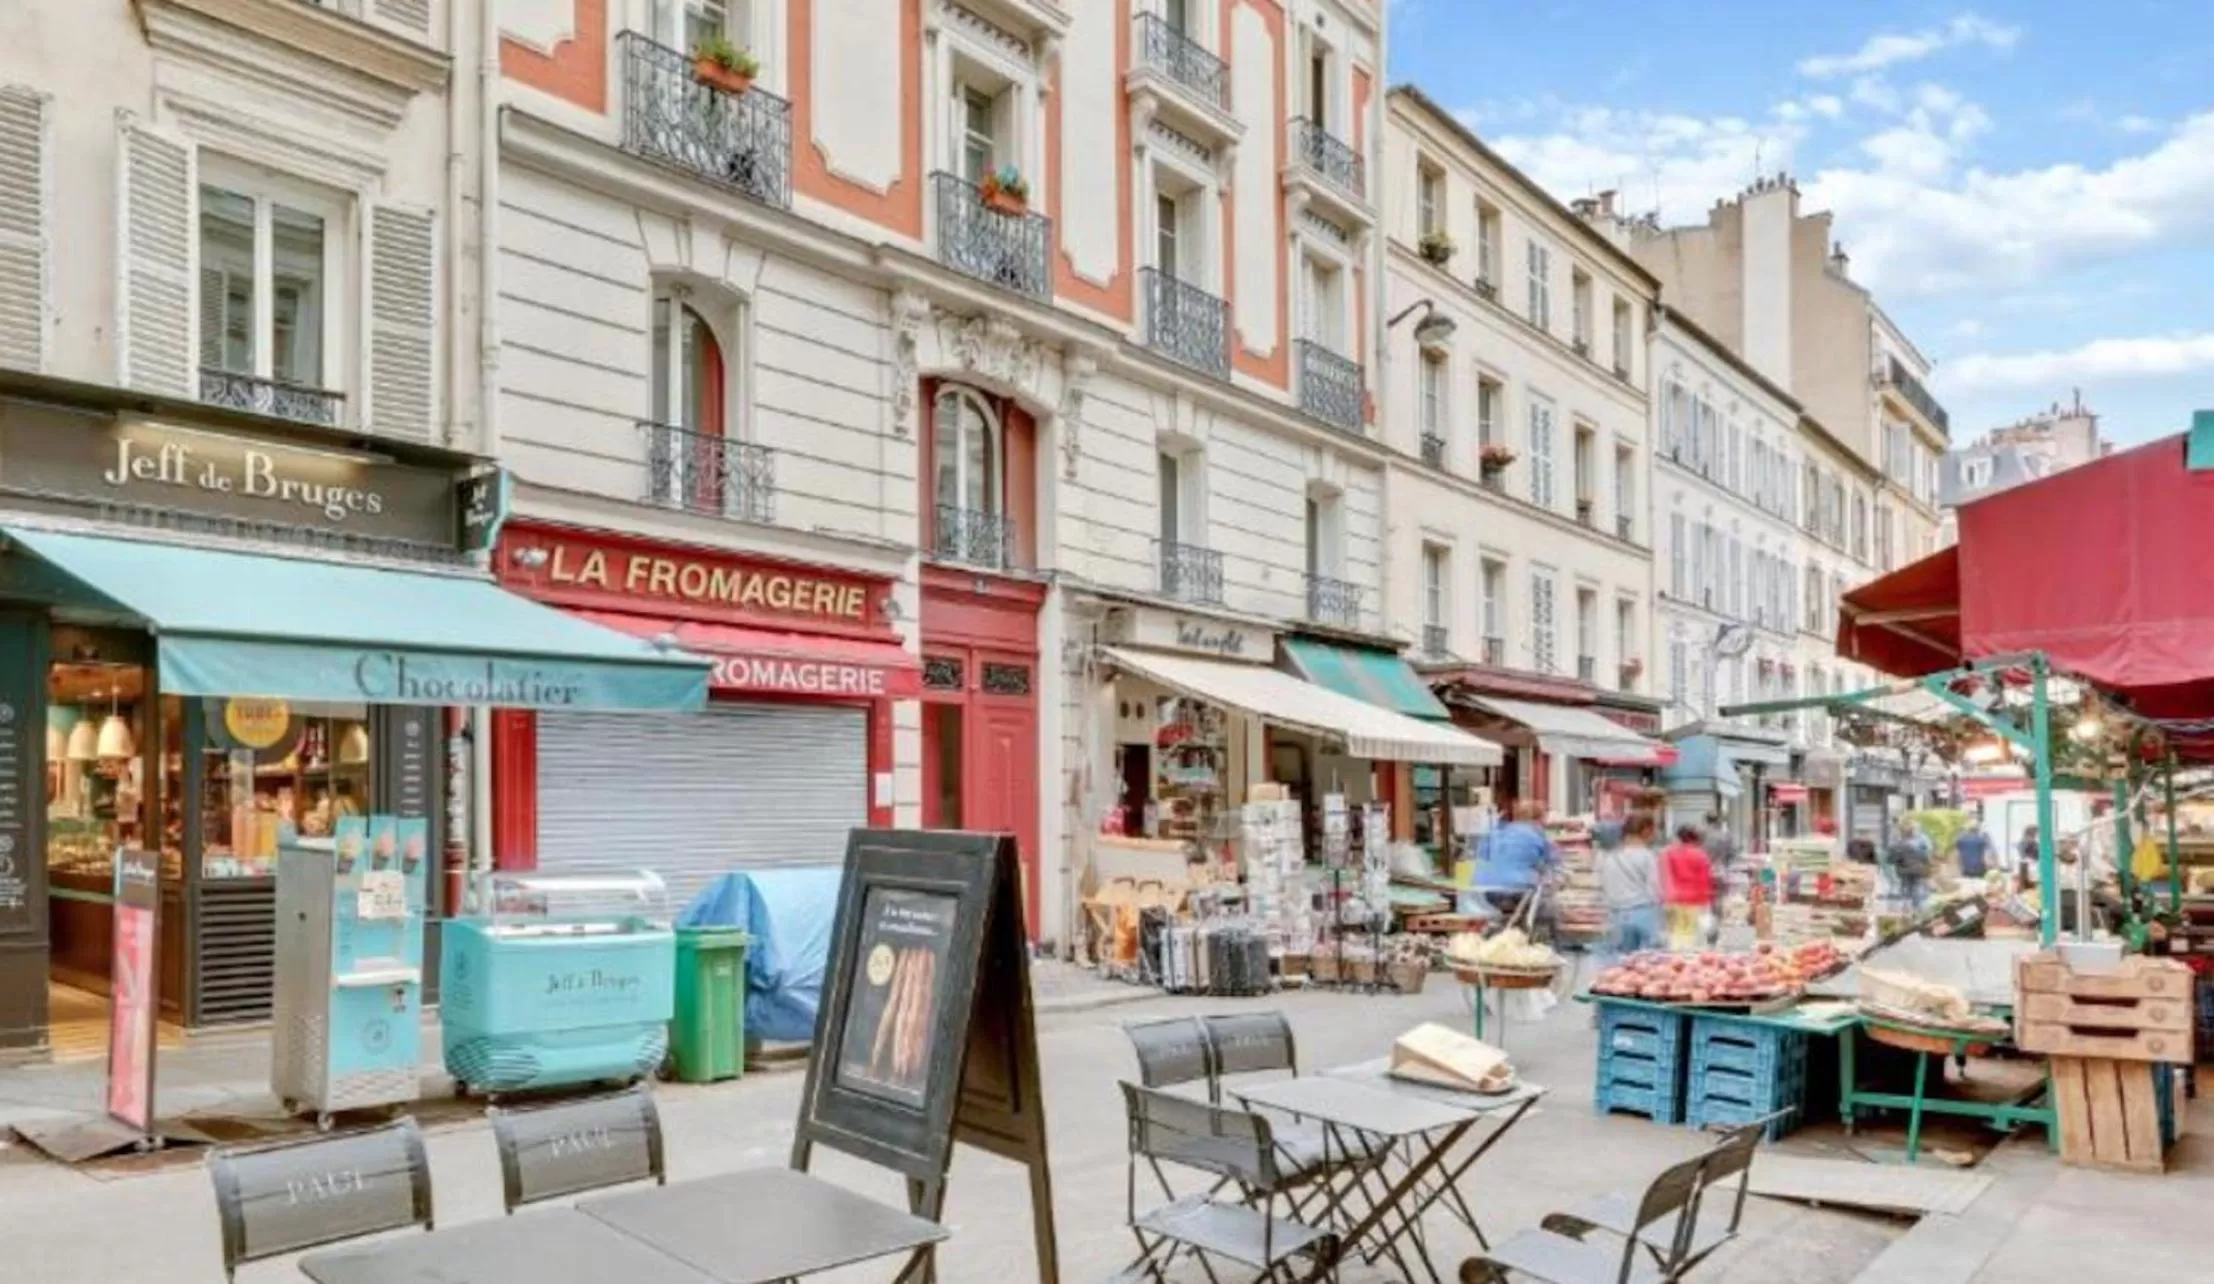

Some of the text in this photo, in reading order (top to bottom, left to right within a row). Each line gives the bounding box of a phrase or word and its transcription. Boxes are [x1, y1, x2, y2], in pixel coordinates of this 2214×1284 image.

[105, 438, 383, 521] Jeff de Bruges
[551, 546, 867, 617] LA FROMAGERIE
[355, 650, 578, 705] Chocolatier
[711, 656, 886, 696] ROMAGERIE
